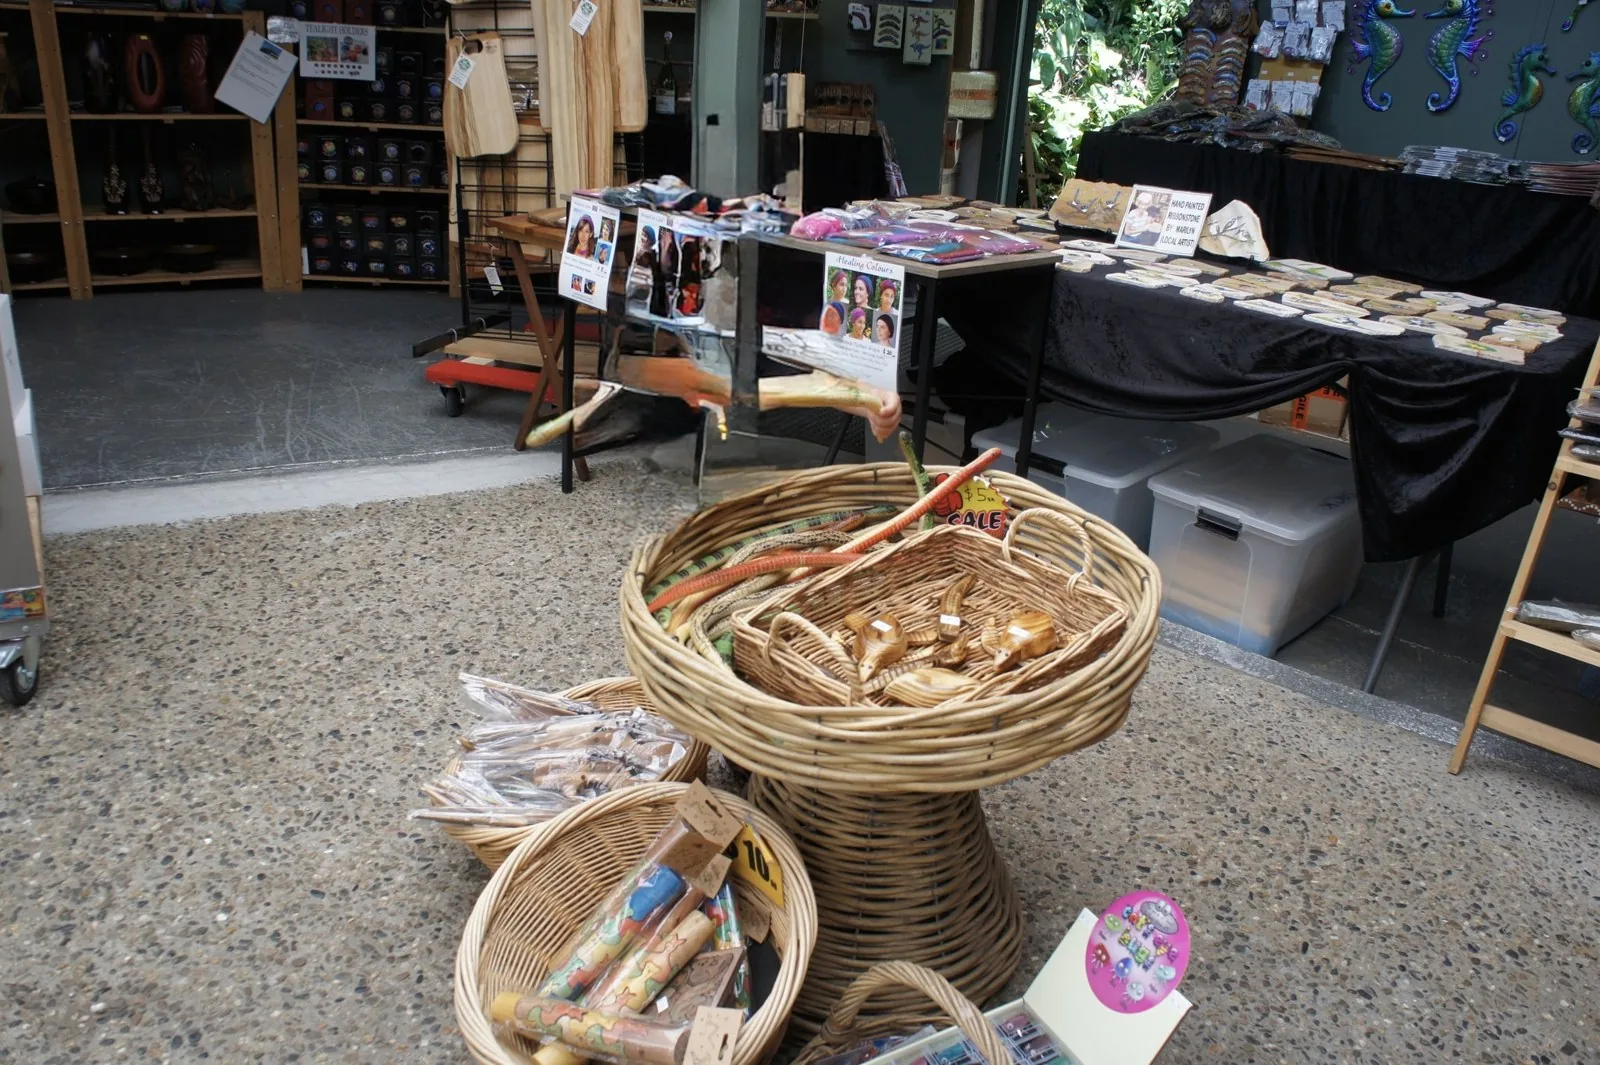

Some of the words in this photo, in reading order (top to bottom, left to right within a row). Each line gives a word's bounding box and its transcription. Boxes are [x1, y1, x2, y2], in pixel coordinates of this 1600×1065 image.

[305, 24, 338, 35] TEALIGHT
[339, 25, 369, 36] HOLDERS
[1172, 200, 1184, 209] HAND
[1185, 202, 1205, 210] PAINTED
[1168, 212, 1200, 222] RIBBONSTONE
[1166, 224, 1173, 232] BY
[1176, 226, 1195, 234] MARILYN
[836, 255, 865, 270] Healing
[866, 260, 894, 274] Colours
[947, 510, 1002, 530] SALE
